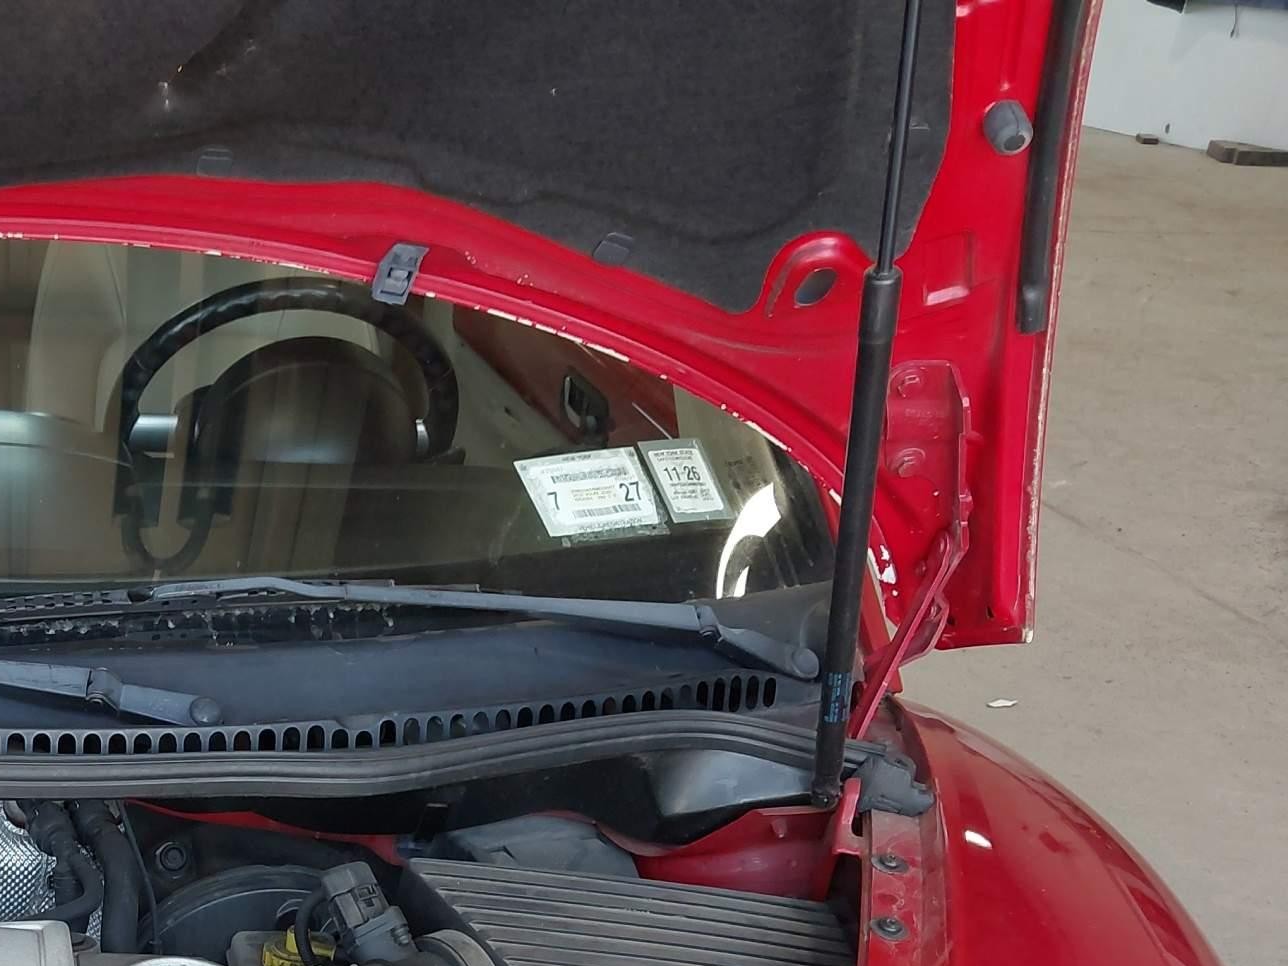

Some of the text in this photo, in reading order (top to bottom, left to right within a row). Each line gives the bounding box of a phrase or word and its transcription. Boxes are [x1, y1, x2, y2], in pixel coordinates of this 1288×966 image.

[664, 465, 701, 481] 11-26
[546, 491, 560, 511] 7
[619, 481, 642, 502] 27
